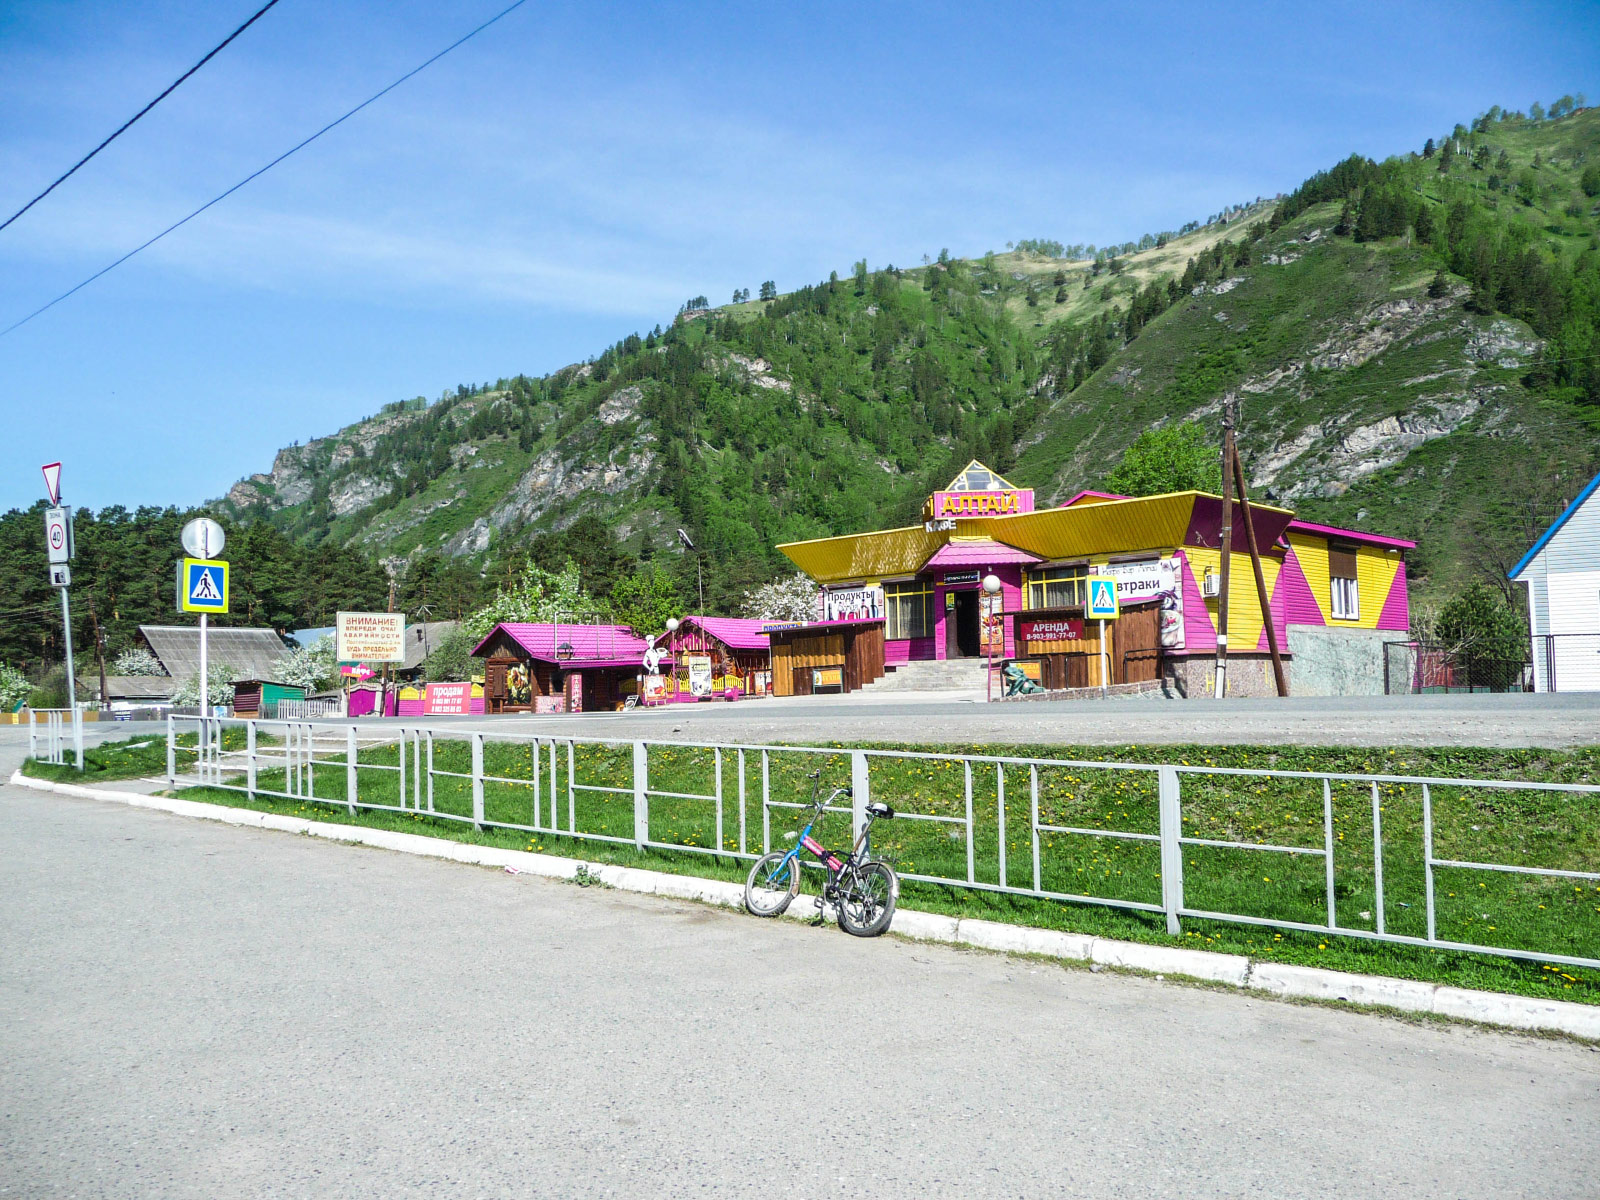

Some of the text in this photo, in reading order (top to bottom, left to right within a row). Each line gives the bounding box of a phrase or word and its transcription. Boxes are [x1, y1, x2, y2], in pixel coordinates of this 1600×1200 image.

[941, 491, 1019, 515] АЛТАЙ
[925, 519, 957, 533] КАФЕ
[52, 531, 61, 542] 40
[1117, 579, 1160, 594] втраки
[827, 590, 873, 604] Продукты
[1032, 622, 1070, 633] АРЕНДА
